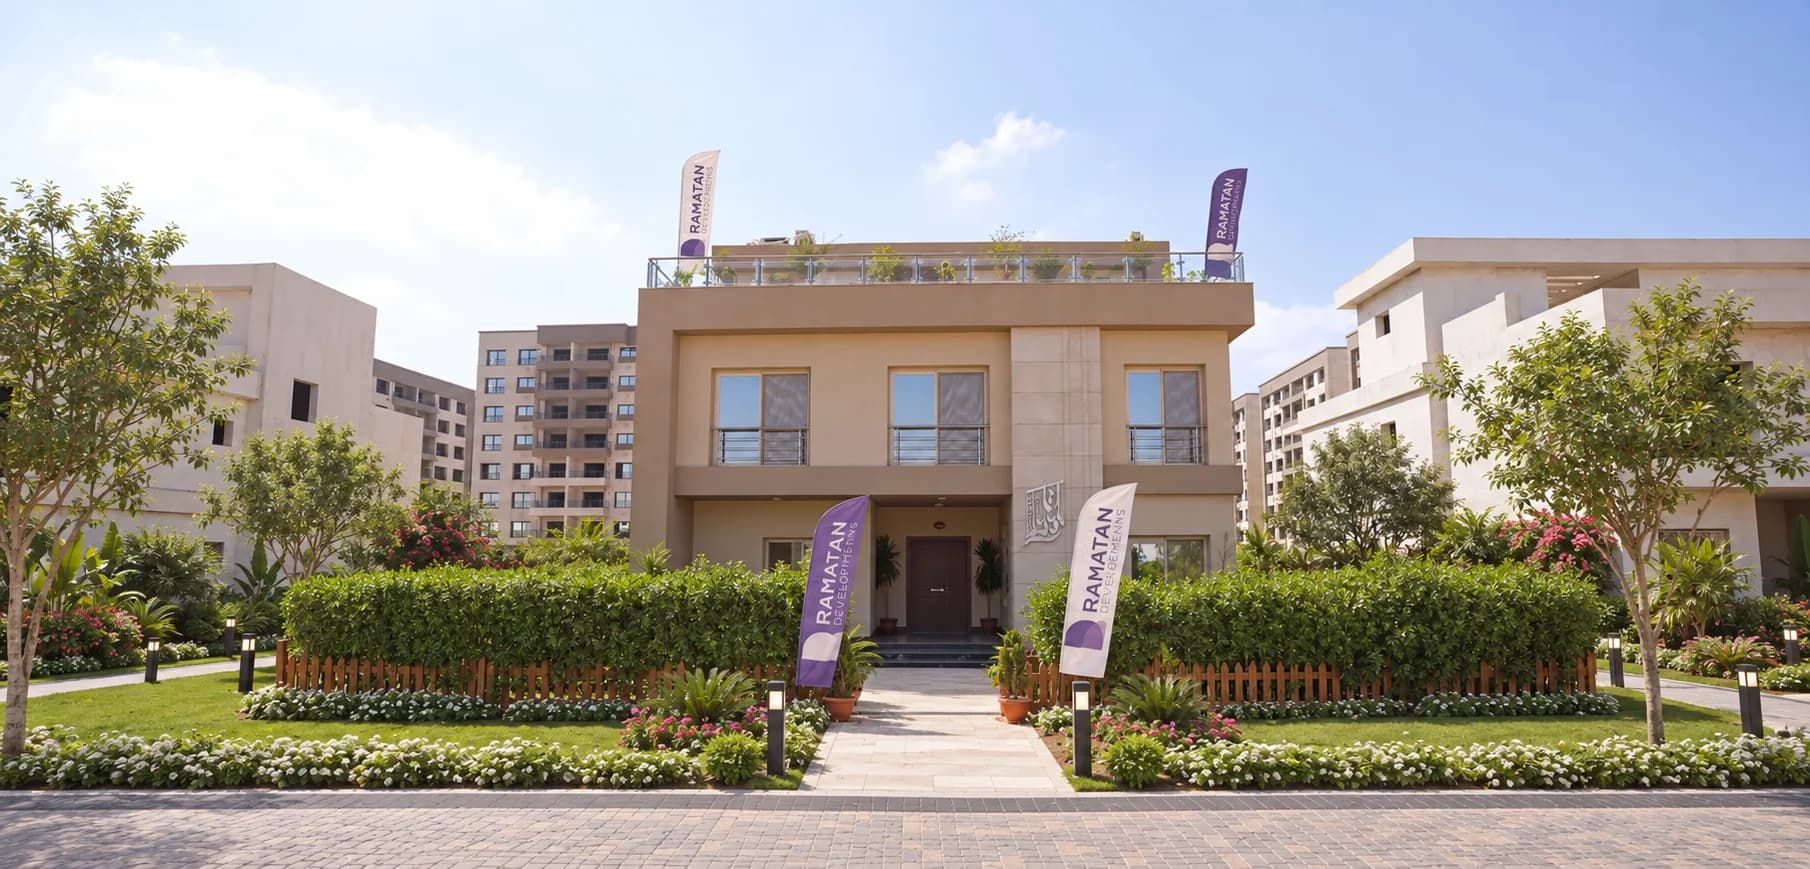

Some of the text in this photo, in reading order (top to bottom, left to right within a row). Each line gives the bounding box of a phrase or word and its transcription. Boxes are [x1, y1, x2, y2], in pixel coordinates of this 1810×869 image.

[690, 164, 705, 234] RAMATAN
[1217, 177, 1235, 239] RAMATAN
[816, 521, 847, 625] RAMATAN
[1082, 507, 1114, 613] RAMATAN
